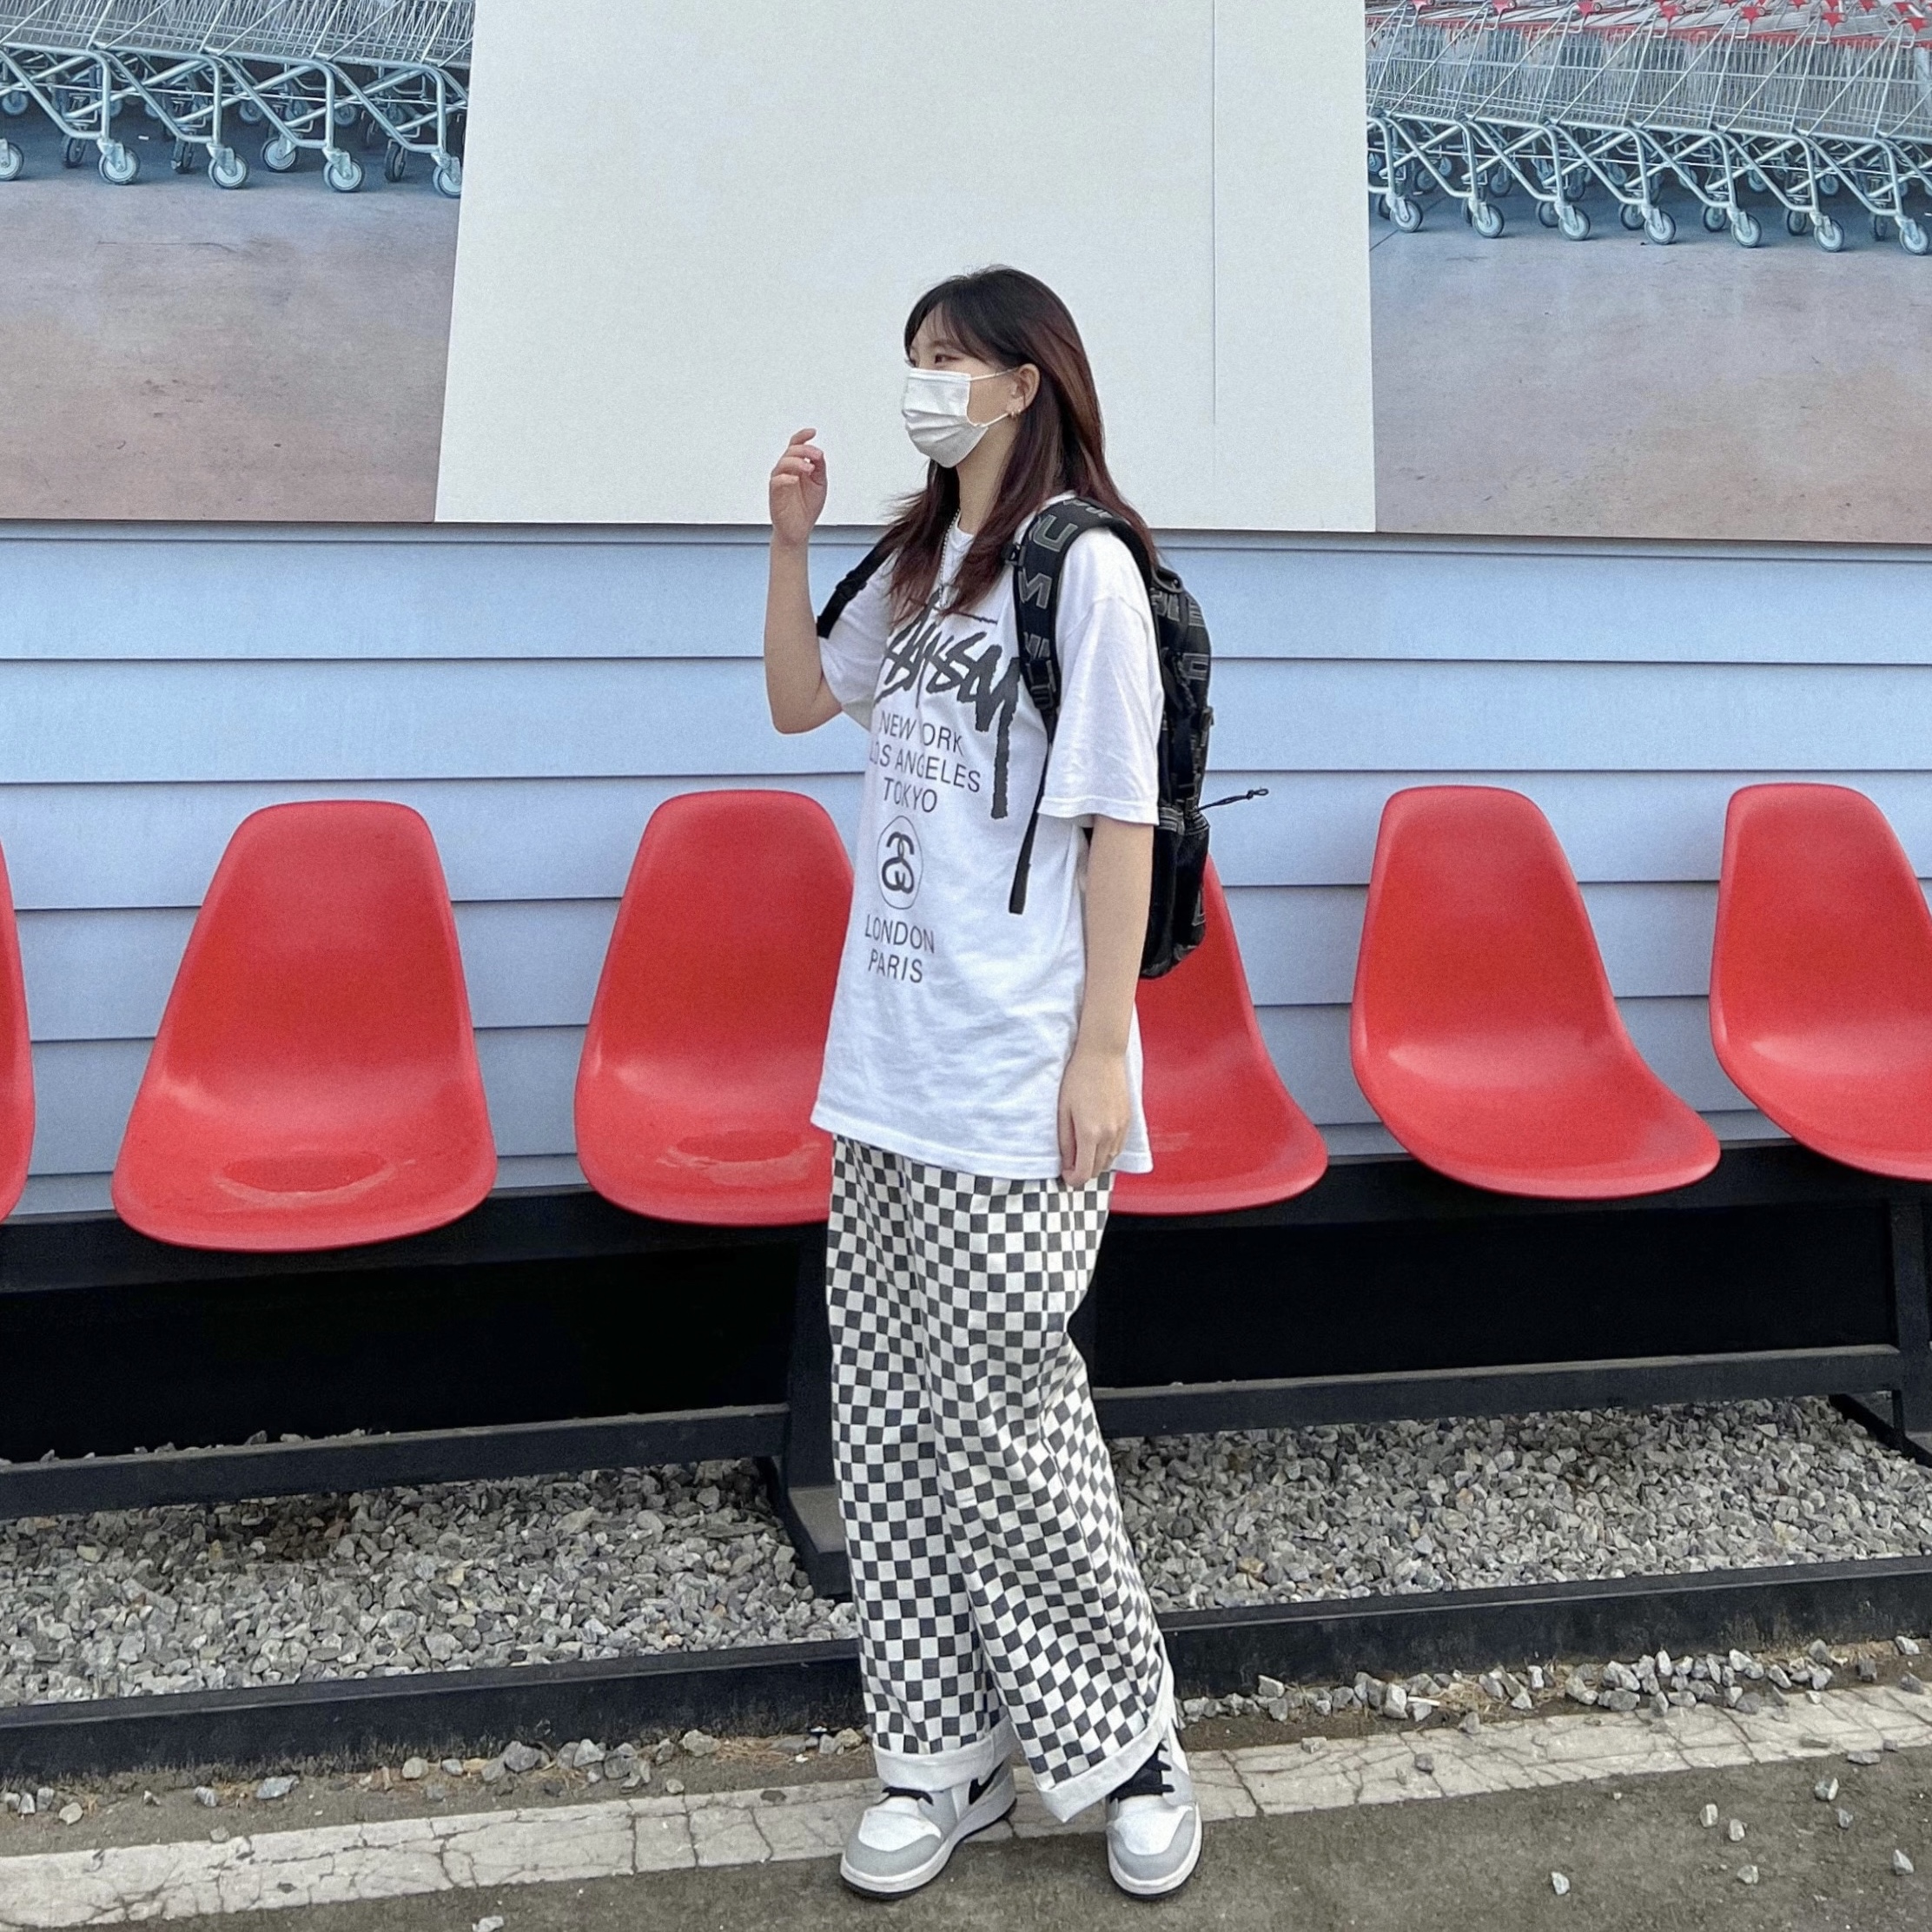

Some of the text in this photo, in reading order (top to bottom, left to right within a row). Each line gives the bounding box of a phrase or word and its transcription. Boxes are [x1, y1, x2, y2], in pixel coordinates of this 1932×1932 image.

[880, 711, 964, 758] NEW ORK
[895, 748, 981, 792] ANGELES
[883, 777, 937, 813] TOKYO
[864, 913, 935, 954] LONDON
[868, 948, 923, 983] PARIS
